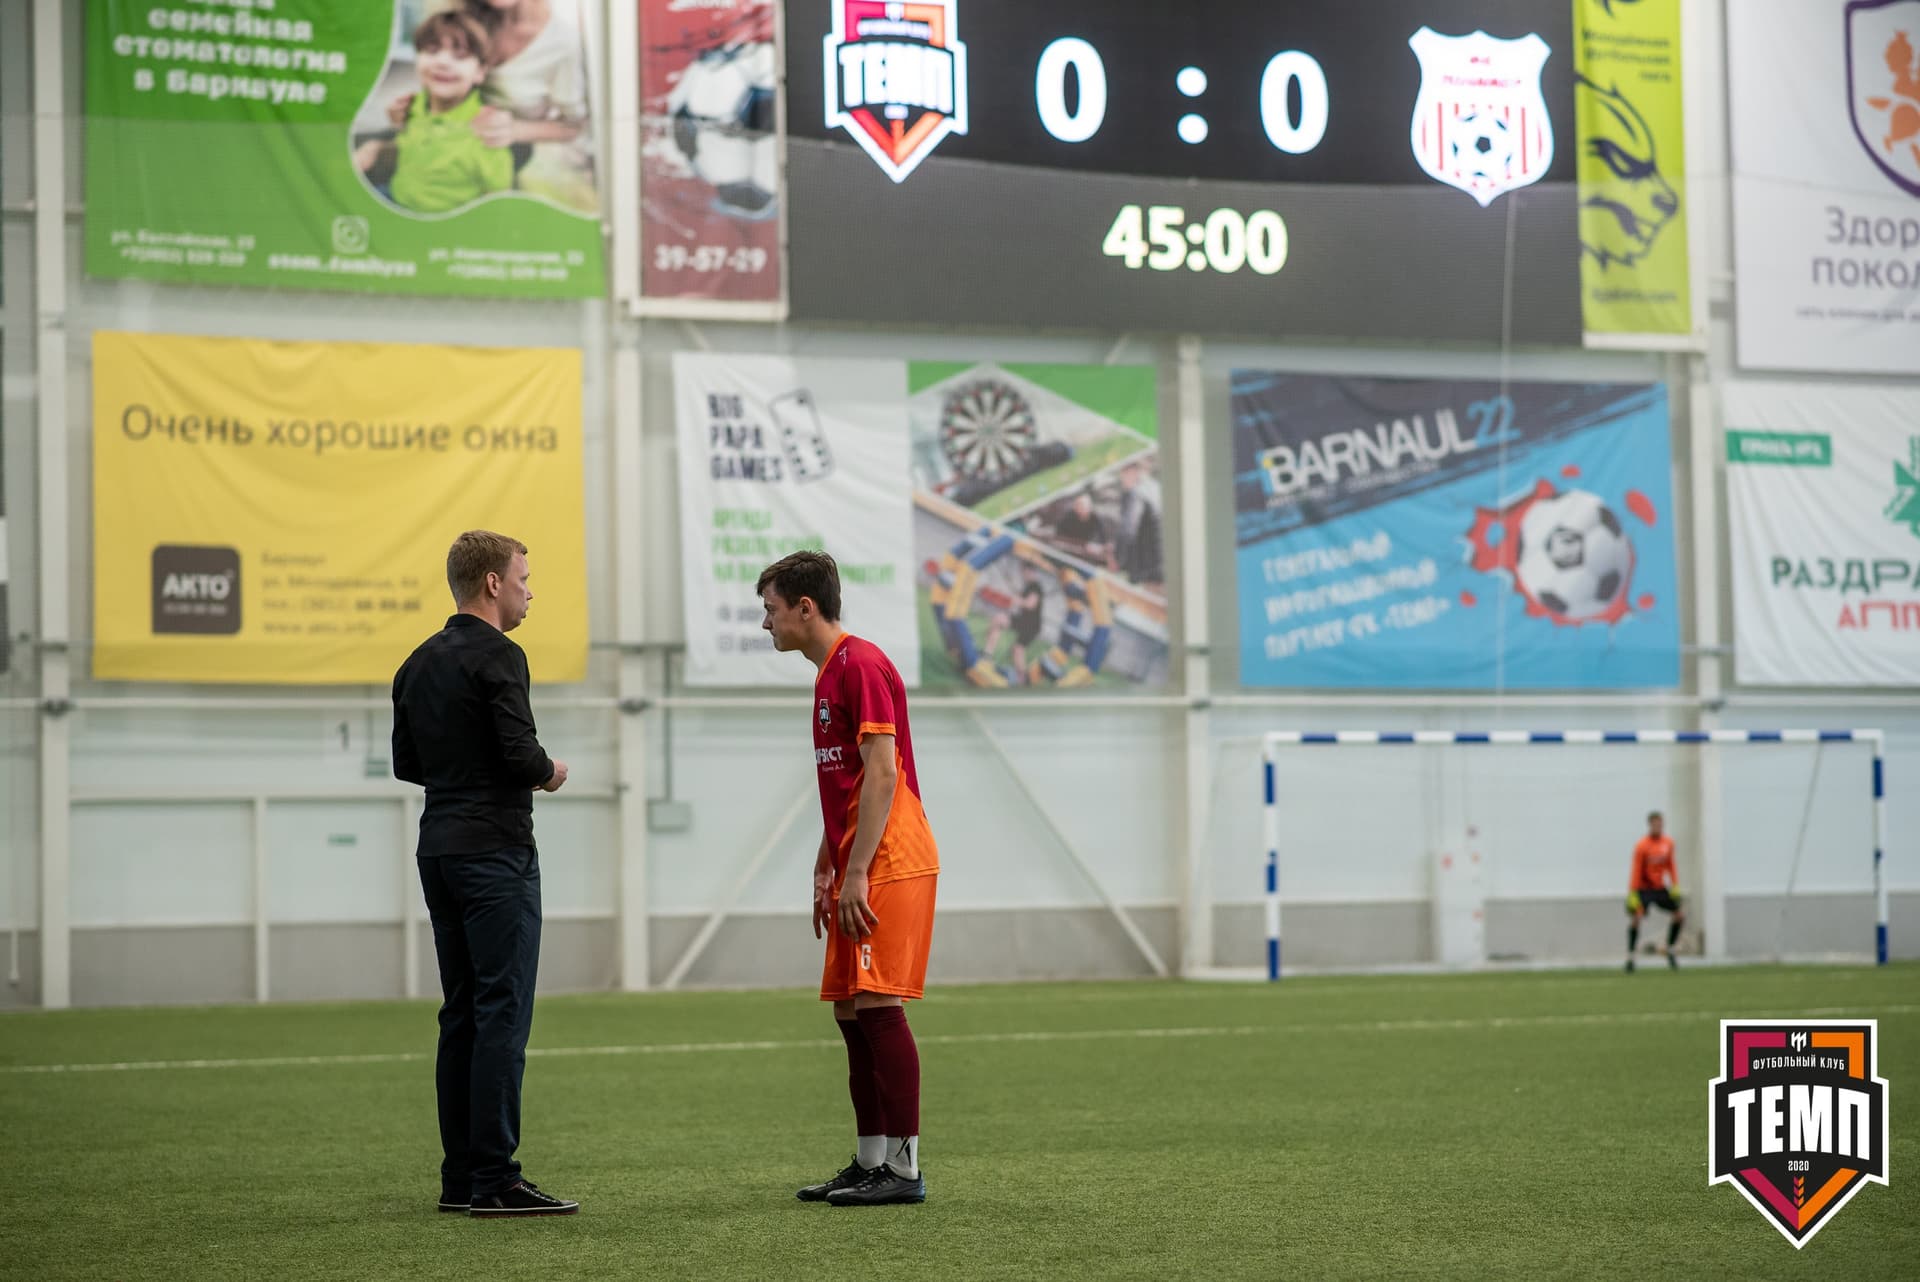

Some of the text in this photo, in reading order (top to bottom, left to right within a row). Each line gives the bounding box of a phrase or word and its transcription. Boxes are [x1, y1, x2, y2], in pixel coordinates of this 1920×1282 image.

[113, 34, 346, 73] стоматология
[134, 69, 327, 104] в Барнауле
[1036, 36, 1107, 143] 0
[1260, 49, 1329, 155] 0
[1102, 204, 1289, 276] 45:00
[1824, 205, 1920, 252] Здор
[122, 403, 558, 456] Очень хорошие окна
[711, 453, 782, 483] GAMES
[860, 943, 872, 970] 6
